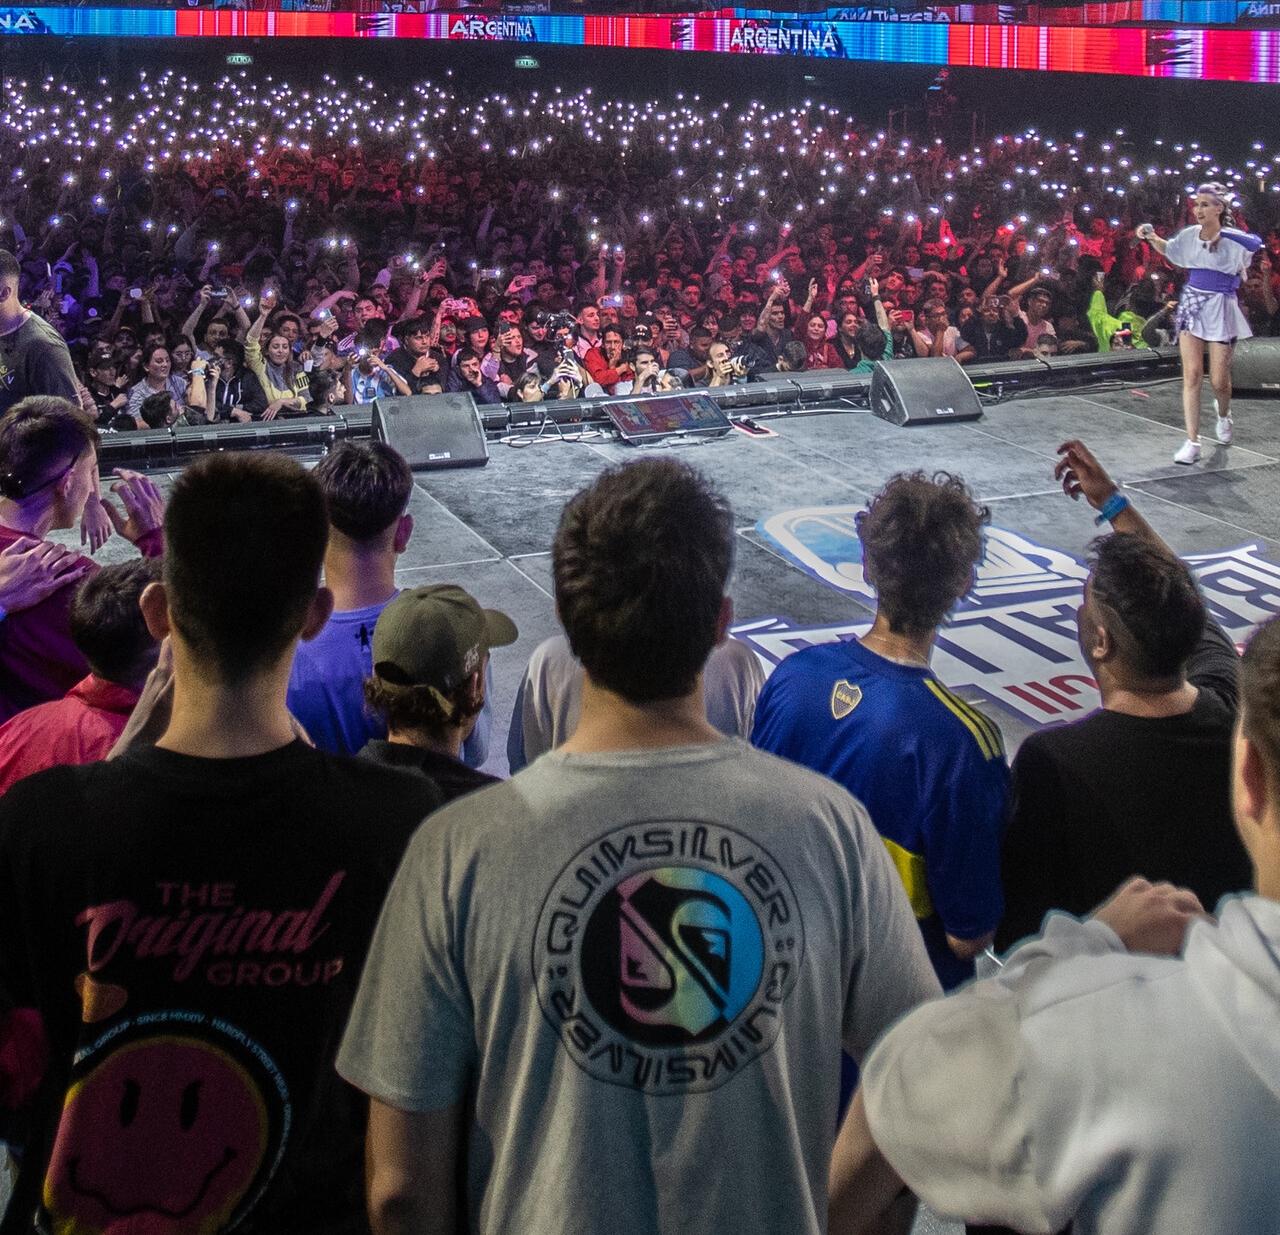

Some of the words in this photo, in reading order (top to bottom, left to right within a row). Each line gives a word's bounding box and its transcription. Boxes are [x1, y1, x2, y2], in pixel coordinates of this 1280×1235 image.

[451, 19, 533, 40] ARGENTINA
[731, 26, 837, 51] ARGENTINA
[226, 55, 253, 65] SALIDA
[156, 882, 236, 907] THE
[547, 826, 791, 957] QUIKSILVER
[74, 871, 347, 982] Original
[206, 958, 344, 987] GROUP
[136, 1012, 167, 1025] SINCE
[550, 962, 791, 1090] QUIKSILVER
